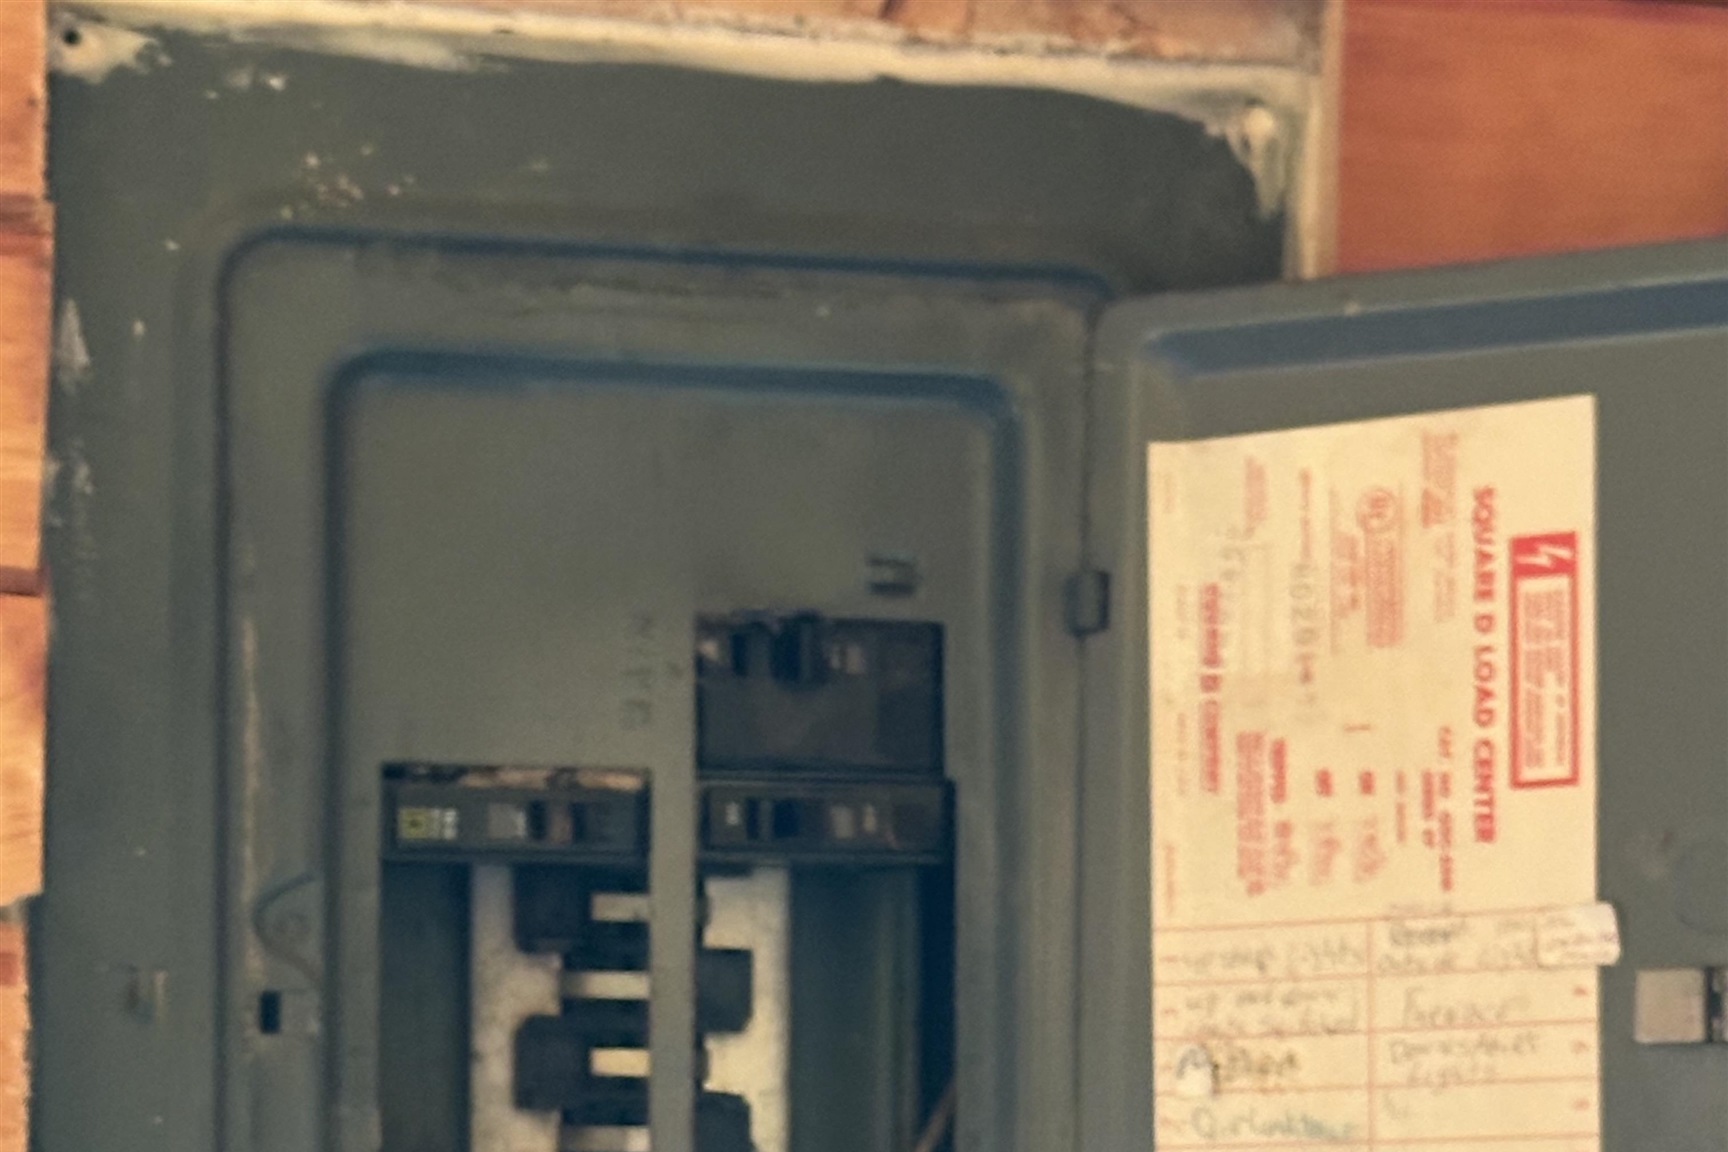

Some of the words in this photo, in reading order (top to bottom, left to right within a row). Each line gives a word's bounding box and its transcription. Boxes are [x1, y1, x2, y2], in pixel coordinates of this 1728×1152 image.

[1472, 485, 1497, 601] SQUARE
[1473, 613, 1496, 634] D
[1473, 648, 1496, 729] LOAD
[1200, 700, 1221, 797] COMPANY
[1473, 739, 1497, 843] CENTER
